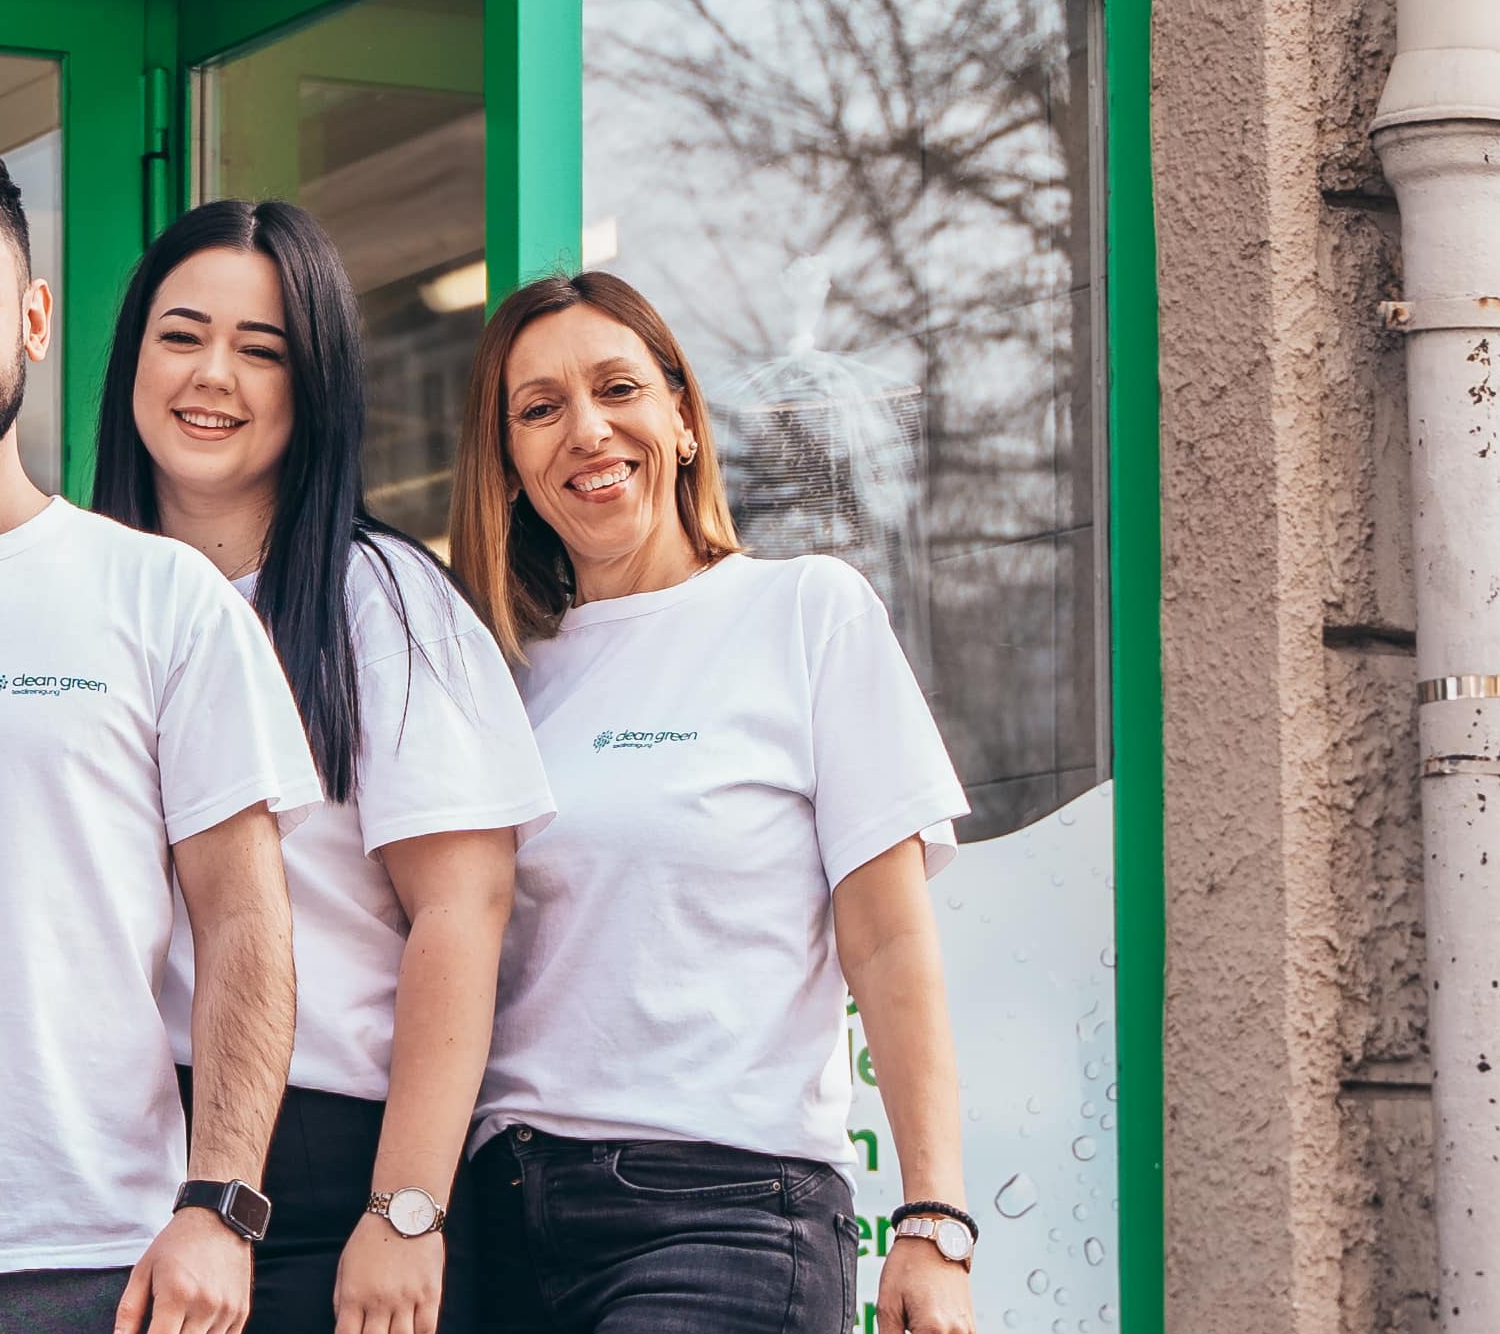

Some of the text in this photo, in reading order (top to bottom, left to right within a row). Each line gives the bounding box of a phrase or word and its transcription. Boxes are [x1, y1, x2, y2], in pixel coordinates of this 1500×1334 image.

[12, 673, 108, 694] clean green
[615, 729, 698, 744] clean green
